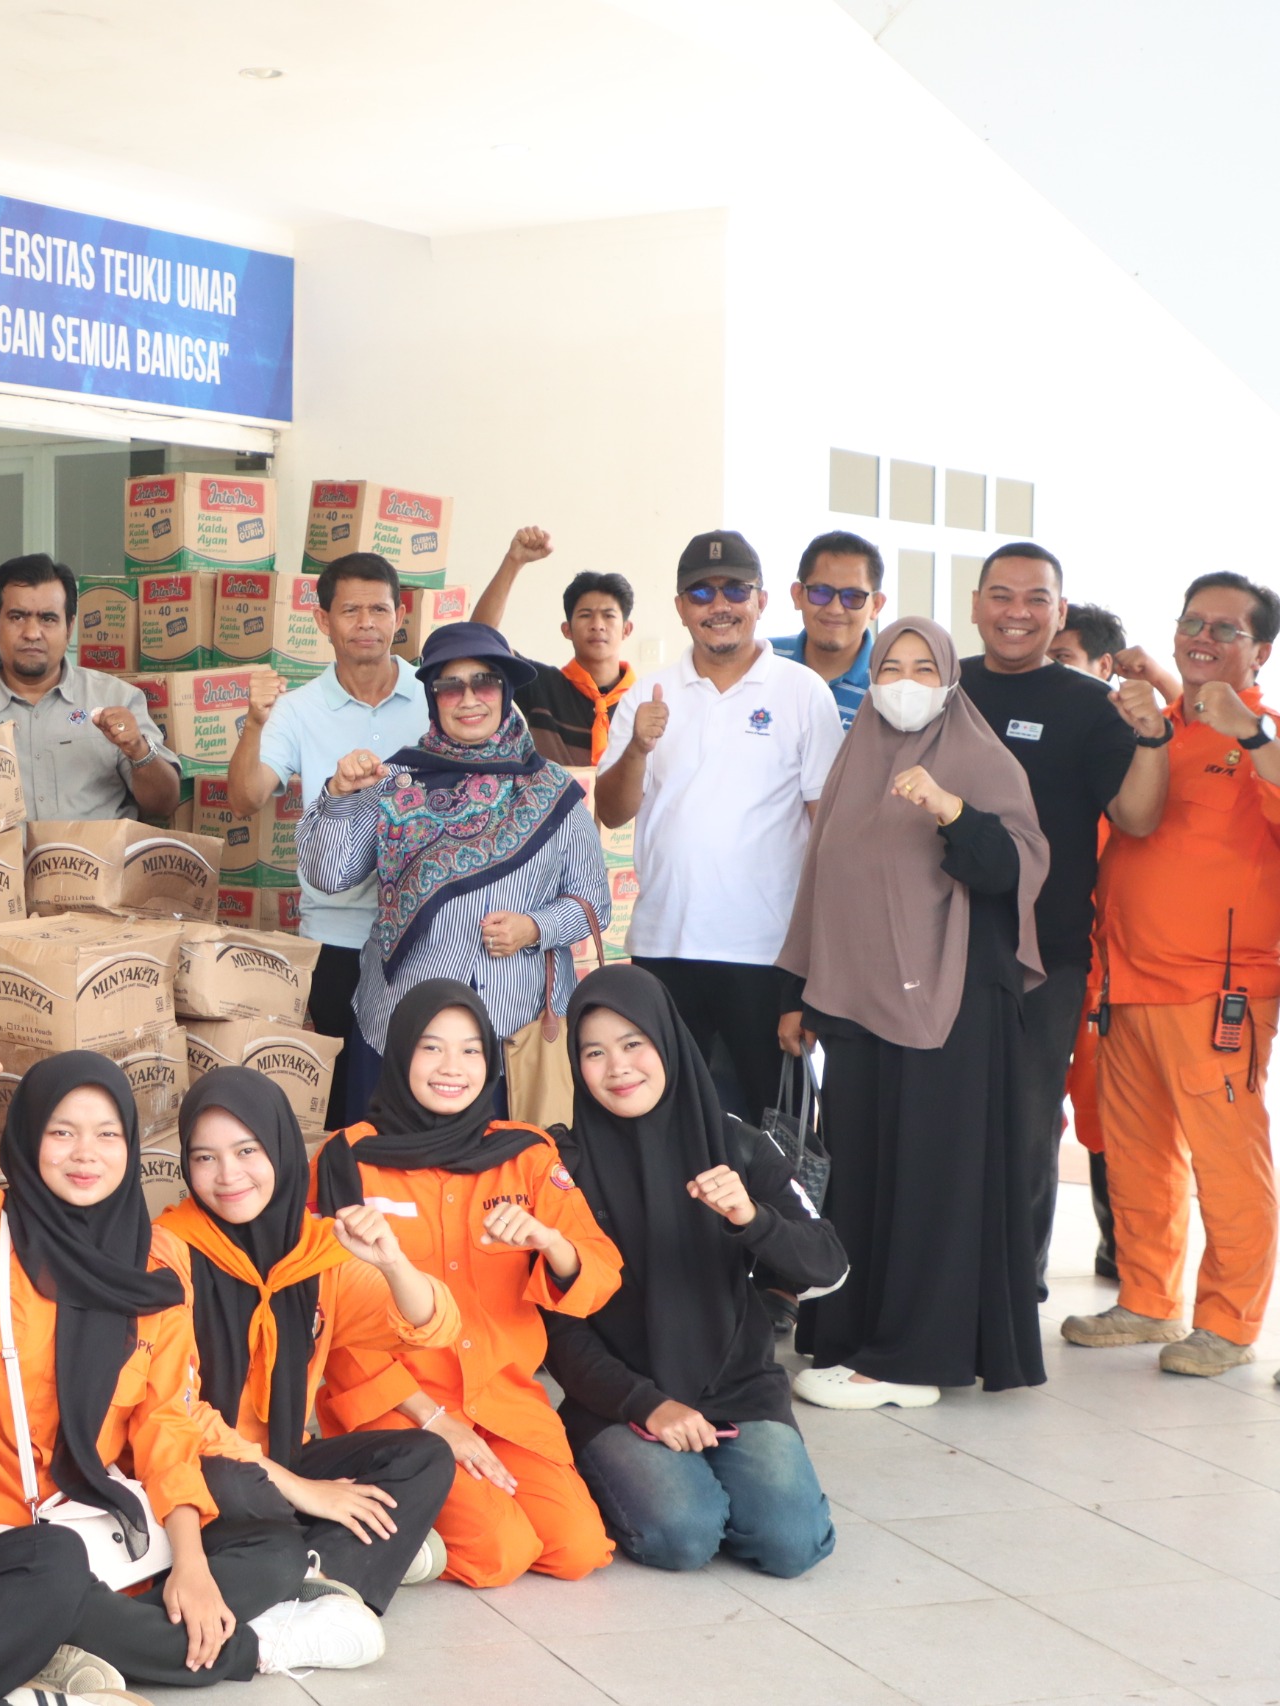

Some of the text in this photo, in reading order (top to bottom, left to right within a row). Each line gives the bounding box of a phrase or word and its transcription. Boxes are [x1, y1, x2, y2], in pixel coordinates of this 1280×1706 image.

[101, 250, 172, 305] TEUKU
[177, 262, 238, 317] UMAR
[52, 319, 130, 373] SEMUA
[137, 337, 229, 385] BANGSA”
[208, 482, 256, 506] InterMi
[144, 508, 156, 518] 40
[198, 513, 222, 521] Rasa
[326, 511, 337, 521] 40
[198, 523, 227, 534] Kaldu
[375, 522, 399, 532] Rasa
[197, 534, 227, 547] Ayam
[373, 531, 403, 544] Kaldu
[372, 543, 401, 557] Ayam
[159, 606, 171, 616] 40
[236, 603, 248, 613] 40
[288, 624, 317, 635] Kaldu
[287, 636, 317, 648] Ayam
[194, 715, 219, 724] Rasa
[195, 725, 225, 737] Kaldu
[195, 738, 226, 751] Ayam
[219, 811, 232, 823] 40
[31, 856, 100, 880] MINYAKITA
[142, 855, 208, 888] MINYAKITA
[231, 952, 299, 988] MINYAKITA
[92, 967, 160, 999] MINYAKITA
[34, 1028, 52, 1036] Pouch
[257, 1053, 320, 1087] MINYAKITA
[483, 1194, 530, 1210] UKM PK
[138, 1339, 154, 1355] PK
